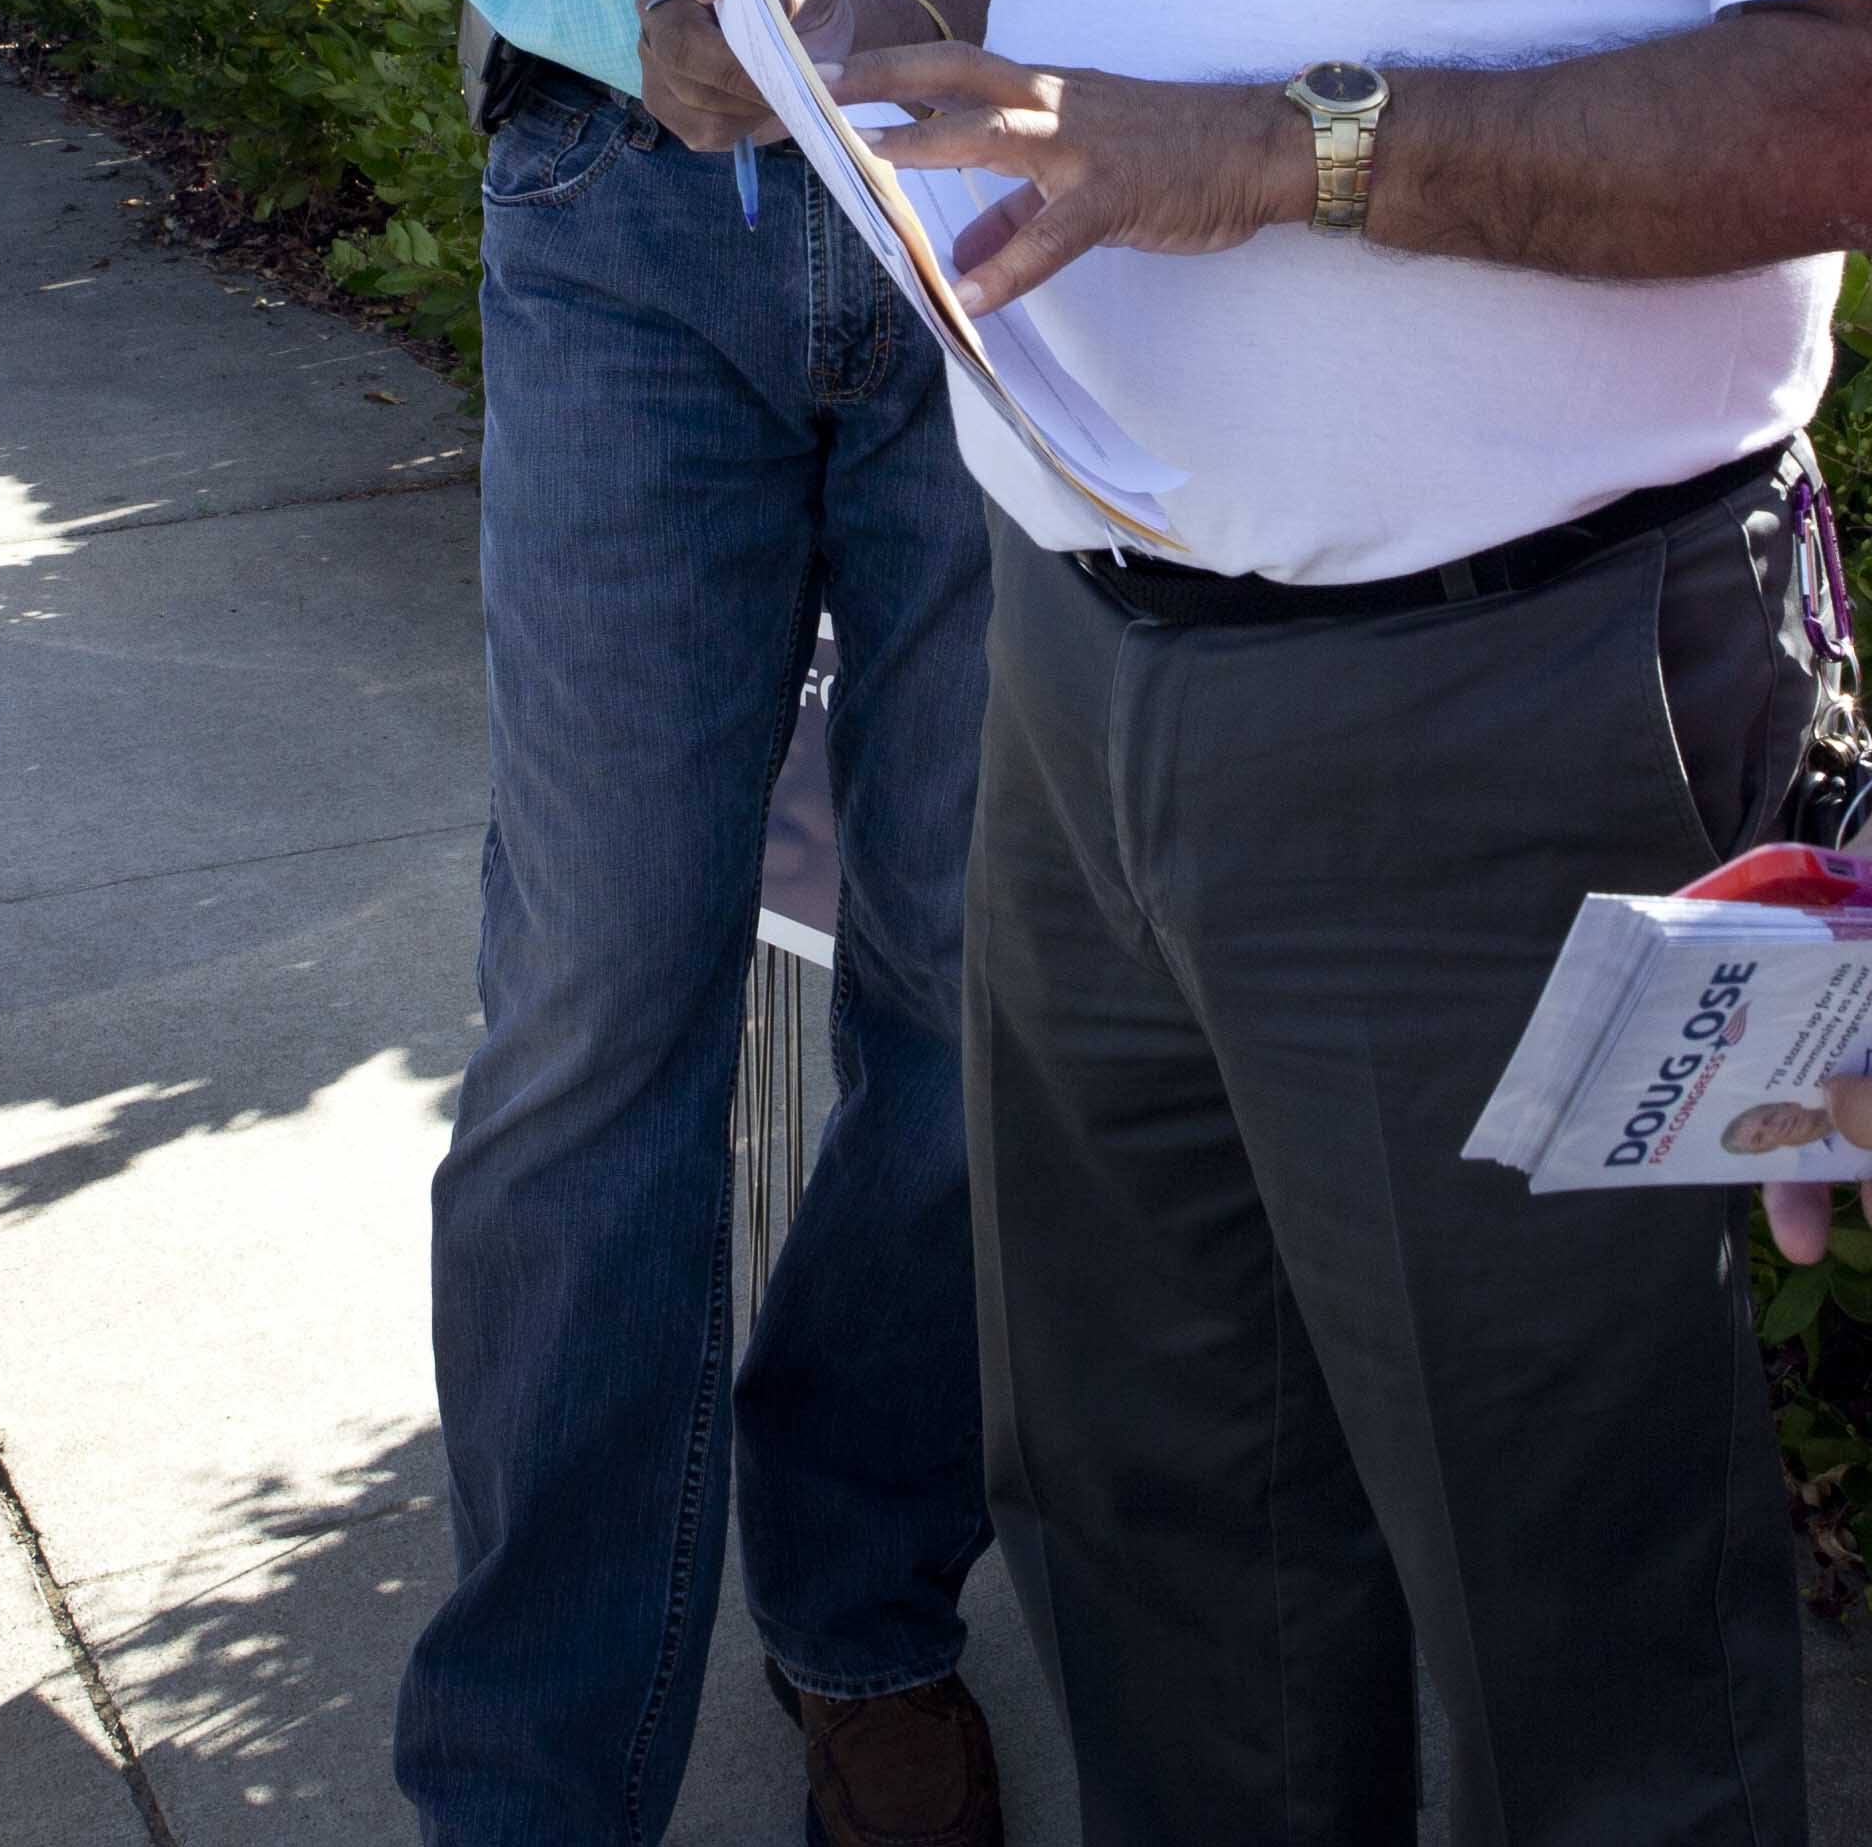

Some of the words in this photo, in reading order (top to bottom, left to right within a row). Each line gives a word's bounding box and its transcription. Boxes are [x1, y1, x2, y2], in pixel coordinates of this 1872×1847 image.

[1829, 962, 1852, 987] this
[1814, 991, 1834, 1010] for
[1792, 1015, 1844, 1087] community
[1836, 998, 1852, 1014] as
[1848, 964, 1871, 997] your
[1806, 1011, 1823, 1030] up
[1604, 1053, 1703, 1167] DOUG
[1682, 961, 1758, 1041] OSE
[1783, 1031, 1810, 1066] stand
[1648, 1135, 1674, 1166] FOR
[1668, 1052, 1726, 1134] CONGRESS
